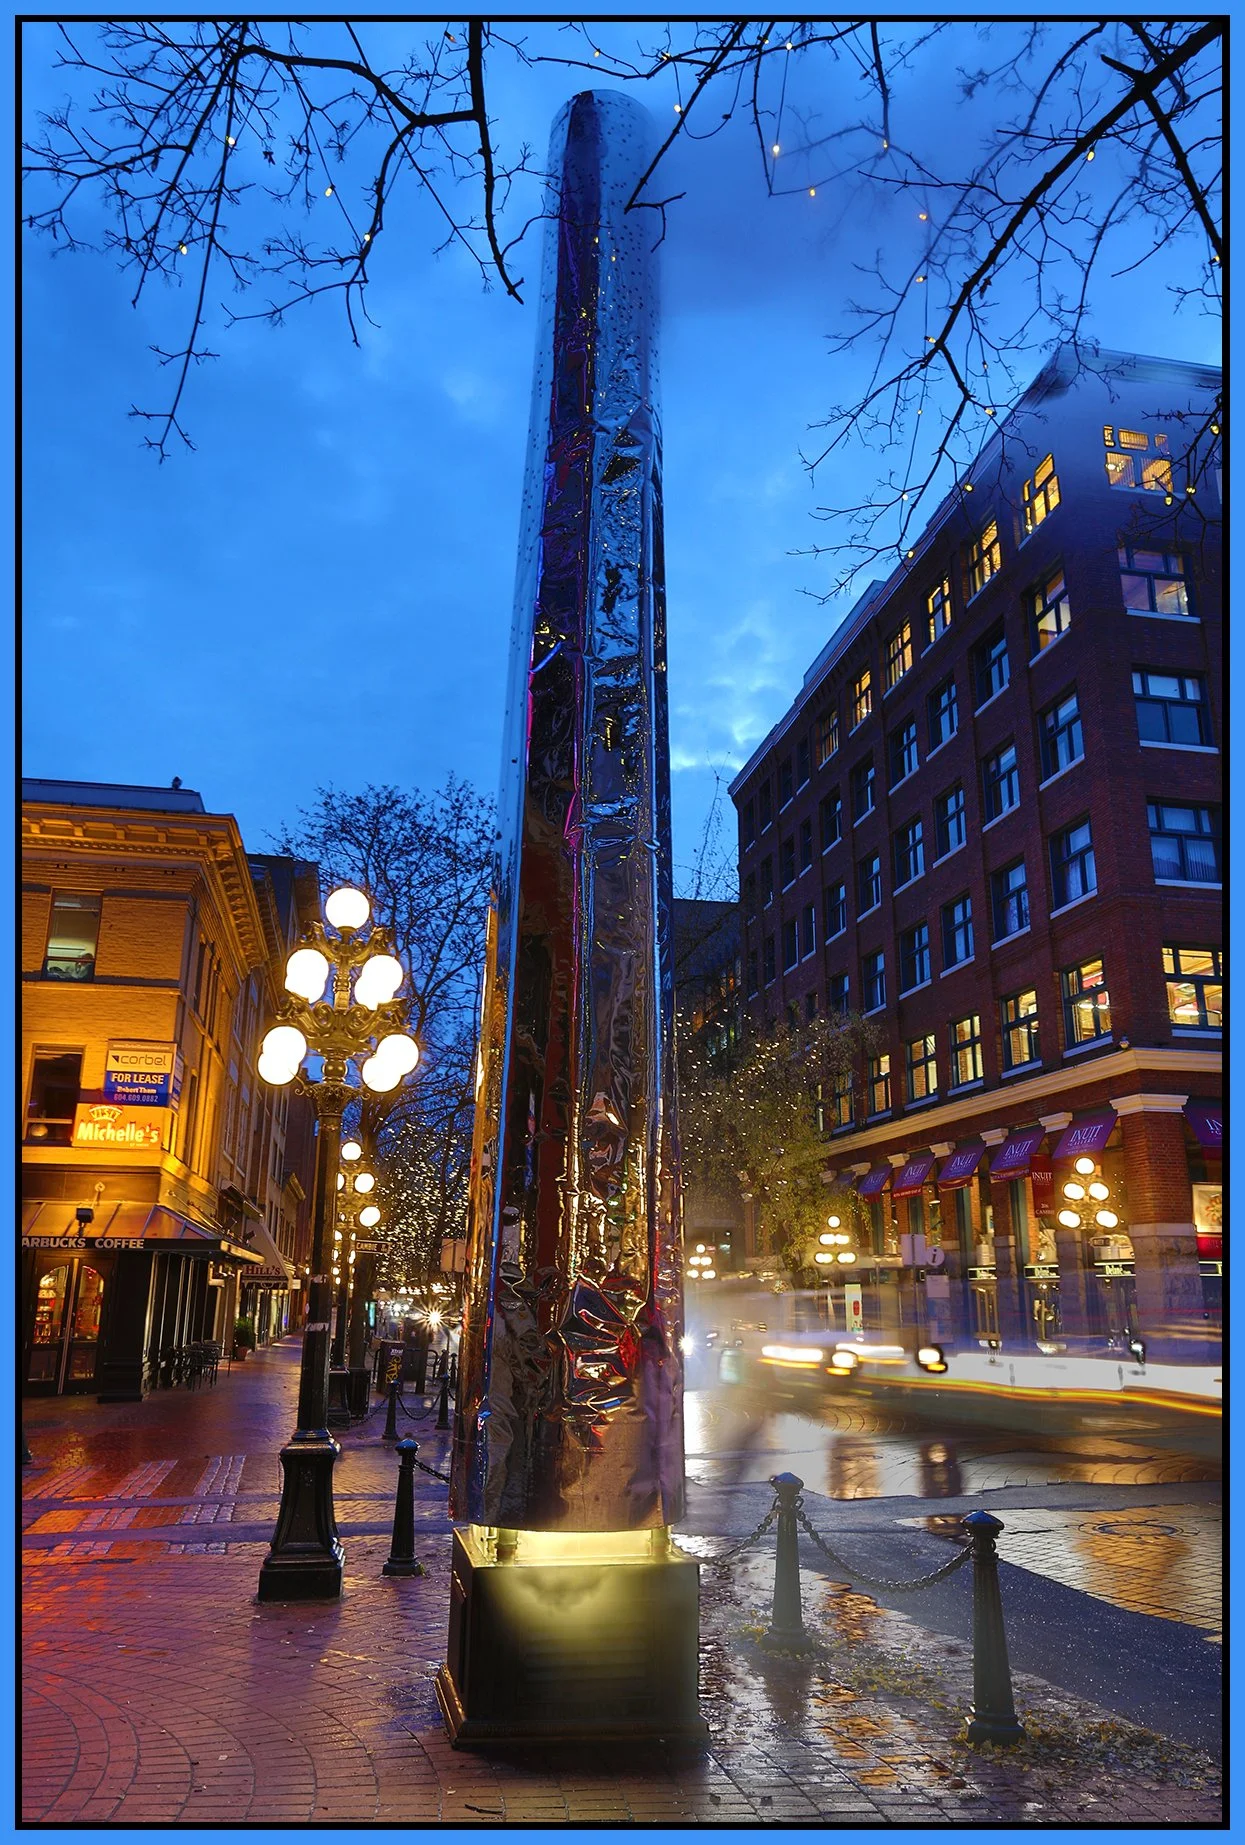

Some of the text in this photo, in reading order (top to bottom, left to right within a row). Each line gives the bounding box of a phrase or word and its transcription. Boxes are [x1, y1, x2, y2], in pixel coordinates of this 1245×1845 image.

[121, 1053, 167, 1066] corbel
[111, 1072, 165, 1085] FOR LEASE
[116, 1085, 138, 1094] Robert
[91, 1107, 121, 1120] VISIT
[76, 1121, 159, 1144] Michelle's
[1069, 1124, 1104, 1142] INUIT
[1004, 1139, 1034, 1157] INUIT
[1031, 1171, 1053, 1180] INUIT
[22, 1237, 145, 1249] ARBUCKS COFFEE
[245, 1265, 281, 1275] HILL'S
